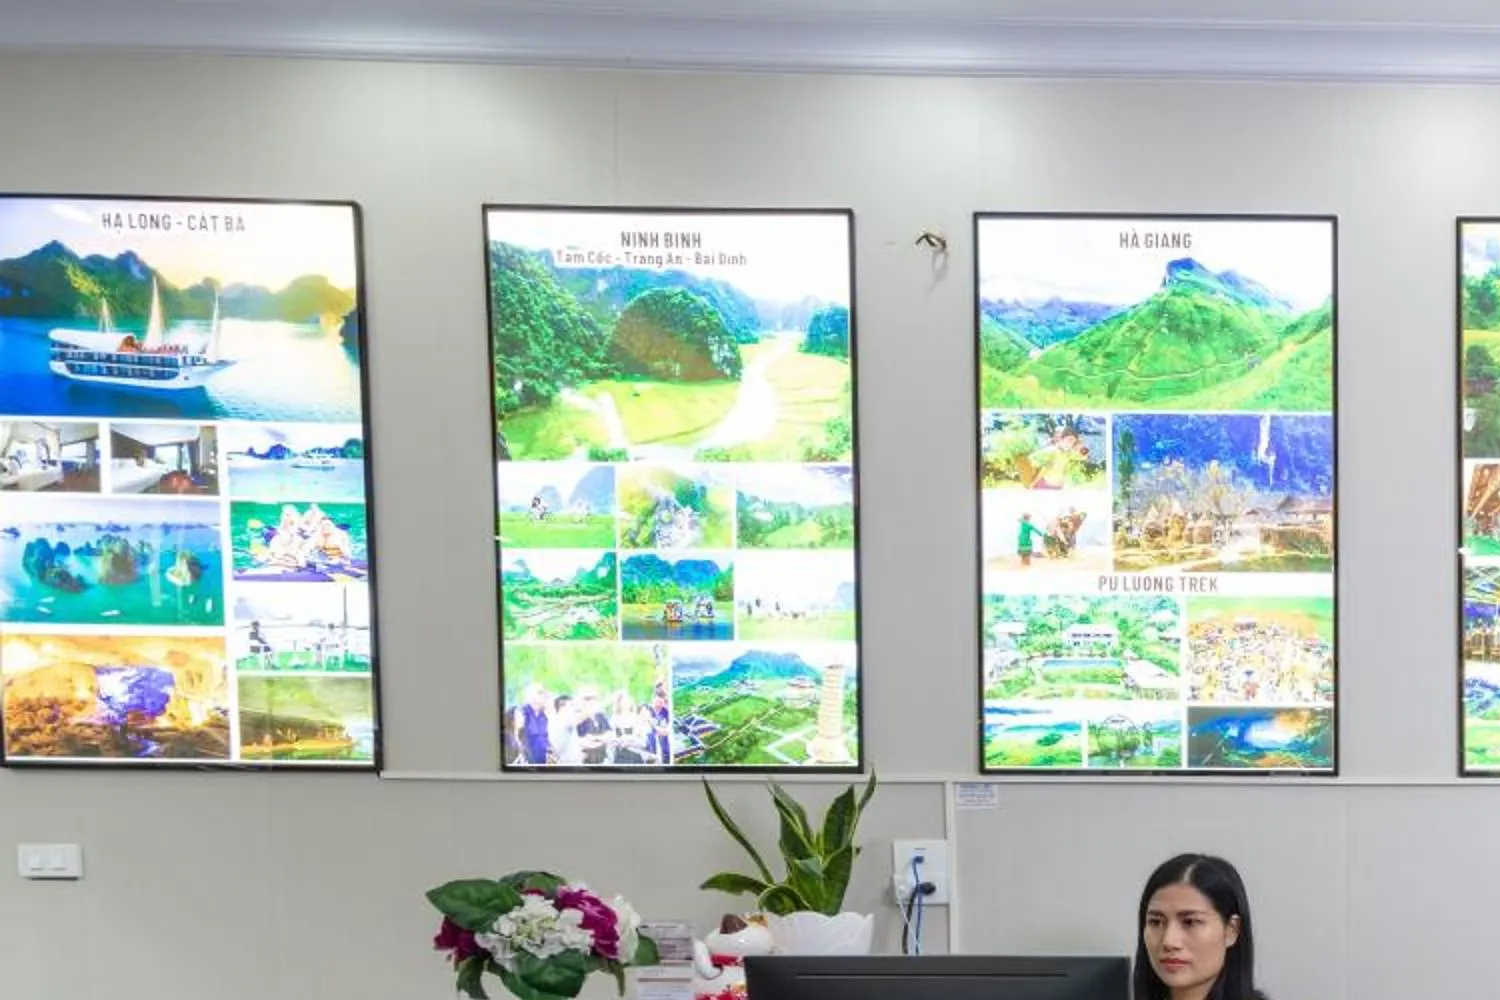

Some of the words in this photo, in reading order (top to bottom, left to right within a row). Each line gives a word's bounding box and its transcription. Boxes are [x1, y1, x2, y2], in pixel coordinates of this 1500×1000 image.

[127, 213, 171, 231] LONG
[620, 231, 660, 249] NINH
[1144, 231, 1193, 249] GIANG
[1123, 576, 1175, 593] LUONG
[1179, 576, 1219, 592] TREK
